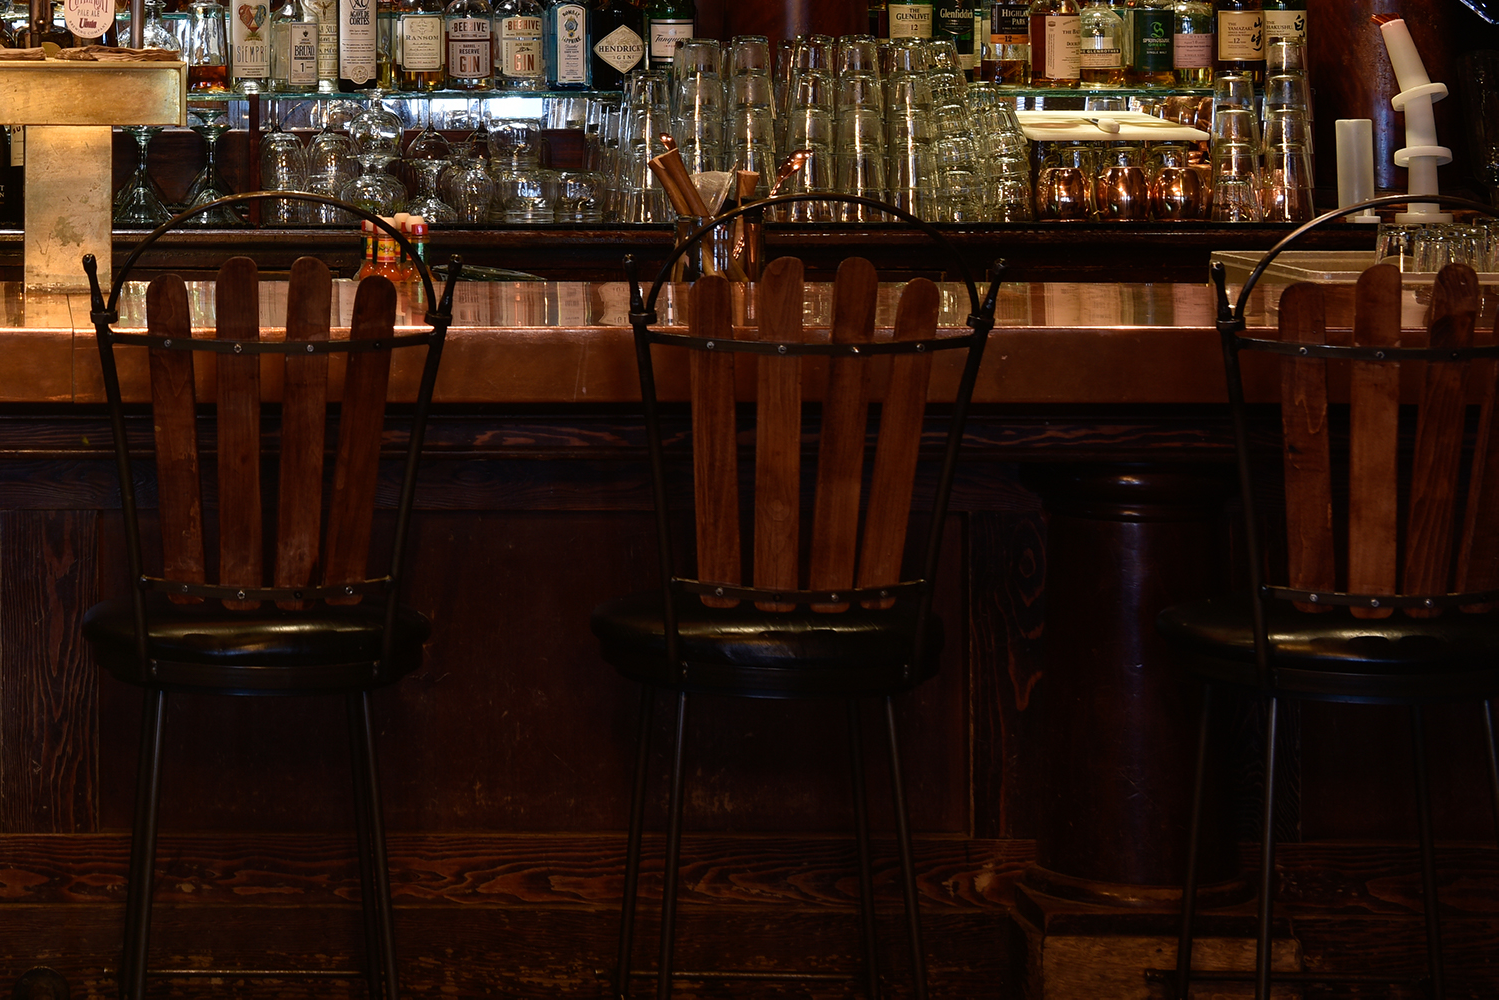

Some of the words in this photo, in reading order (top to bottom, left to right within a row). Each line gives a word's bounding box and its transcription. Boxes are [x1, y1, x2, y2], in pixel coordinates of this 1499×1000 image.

[78, 9, 89, 17] PALE
[69, 20, 88, 35] BREWING
[88, 22, 107, 35] COMPANY
[453, 21, 487, 32] BEEHIVE
[507, 20, 540, 31] BEEHIVE
[295, 45, 314, 56] BRUXO
[460, 55, 480, 72] GIN
[514, 54, 534, 71] GIN
